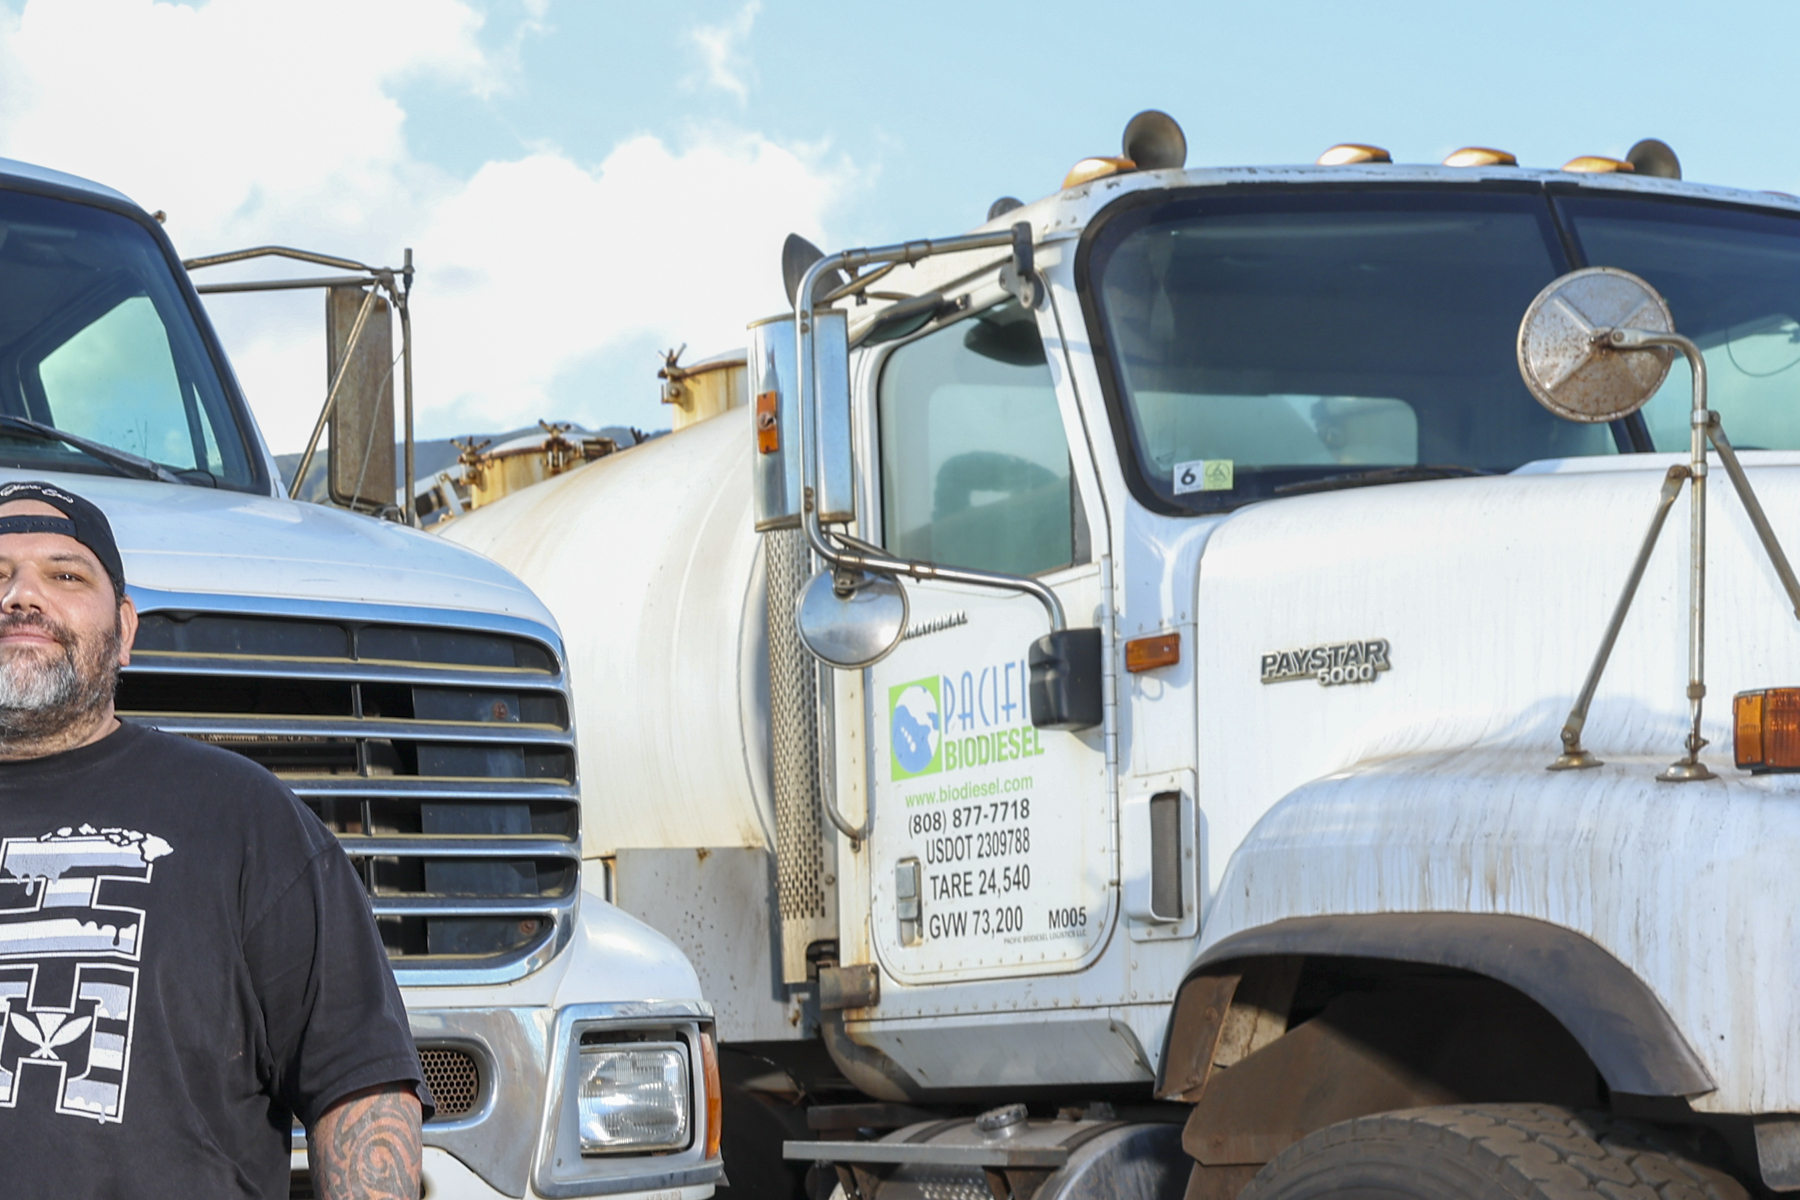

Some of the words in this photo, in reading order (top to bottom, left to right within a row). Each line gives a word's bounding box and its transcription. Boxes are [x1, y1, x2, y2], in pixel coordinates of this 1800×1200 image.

[1181, 468, 1196, 486] 6
[1261, 639, 1388, 680] PAYSTAR
[1317, 663, 1374, 687] 5000
[943, 659, 1026, 735] PACIFI
[945, 725, 1045, 771] BIODIESEL
[905, 776, 1033, 808] www.biodiesel.com
[909, 810, 947, 839] (808)
[953, 798, 1030, 829] 877-7718
[926, 834, 973, 864] USDOT
[977, 827, 1030, 859] 2309788
[930, 871, 973, 900] TARE
[978, 864, 1030, 899] 24,540
[929, 911, 967, 940] GVW
[973, 905, 1023, 939] 73,200
[1048, 906, 1087, 930] M005
